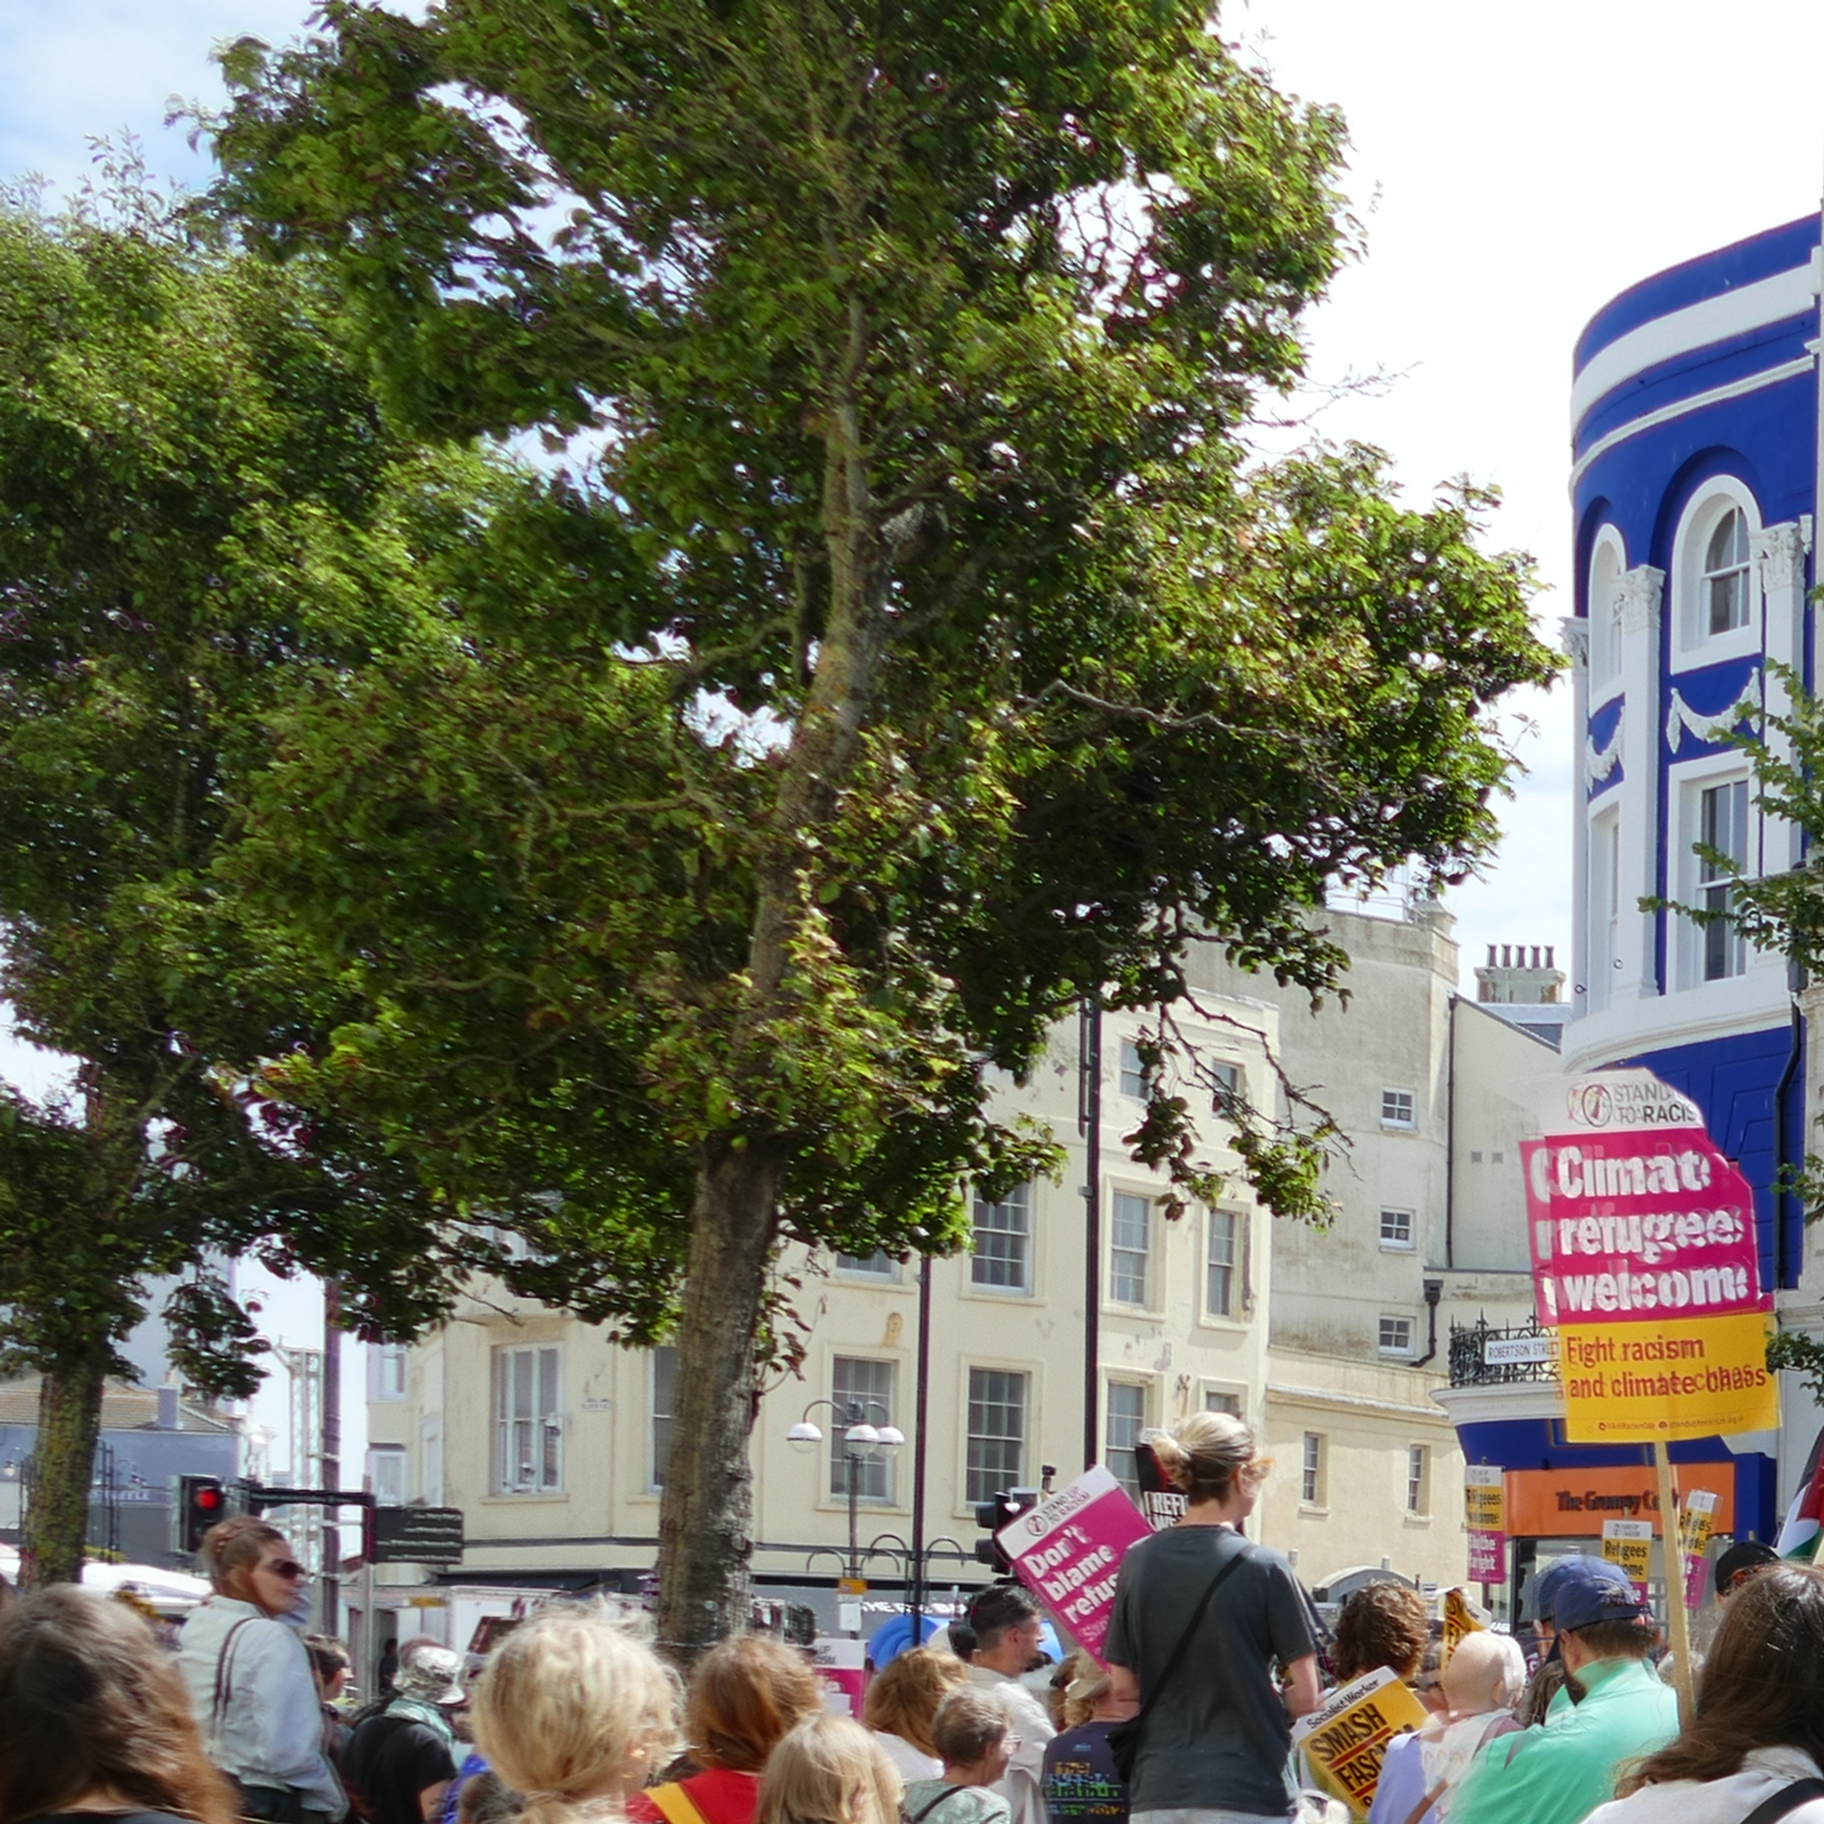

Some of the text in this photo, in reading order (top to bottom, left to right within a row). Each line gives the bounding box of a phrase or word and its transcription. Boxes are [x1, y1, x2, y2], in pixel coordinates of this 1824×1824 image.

[1622, 1333, 1706, 1362] racism
[1568, 1371, 1604, 1399] and
[1610, 1368, 1696, 1399] climate
[1555, 1490, 1582, 1512] The
[1021, 1525, 1089, 1579] Don't
[1041, 1544, 1116, 1602] blame
[1308, 1702, 1388, 1763] SMASH
